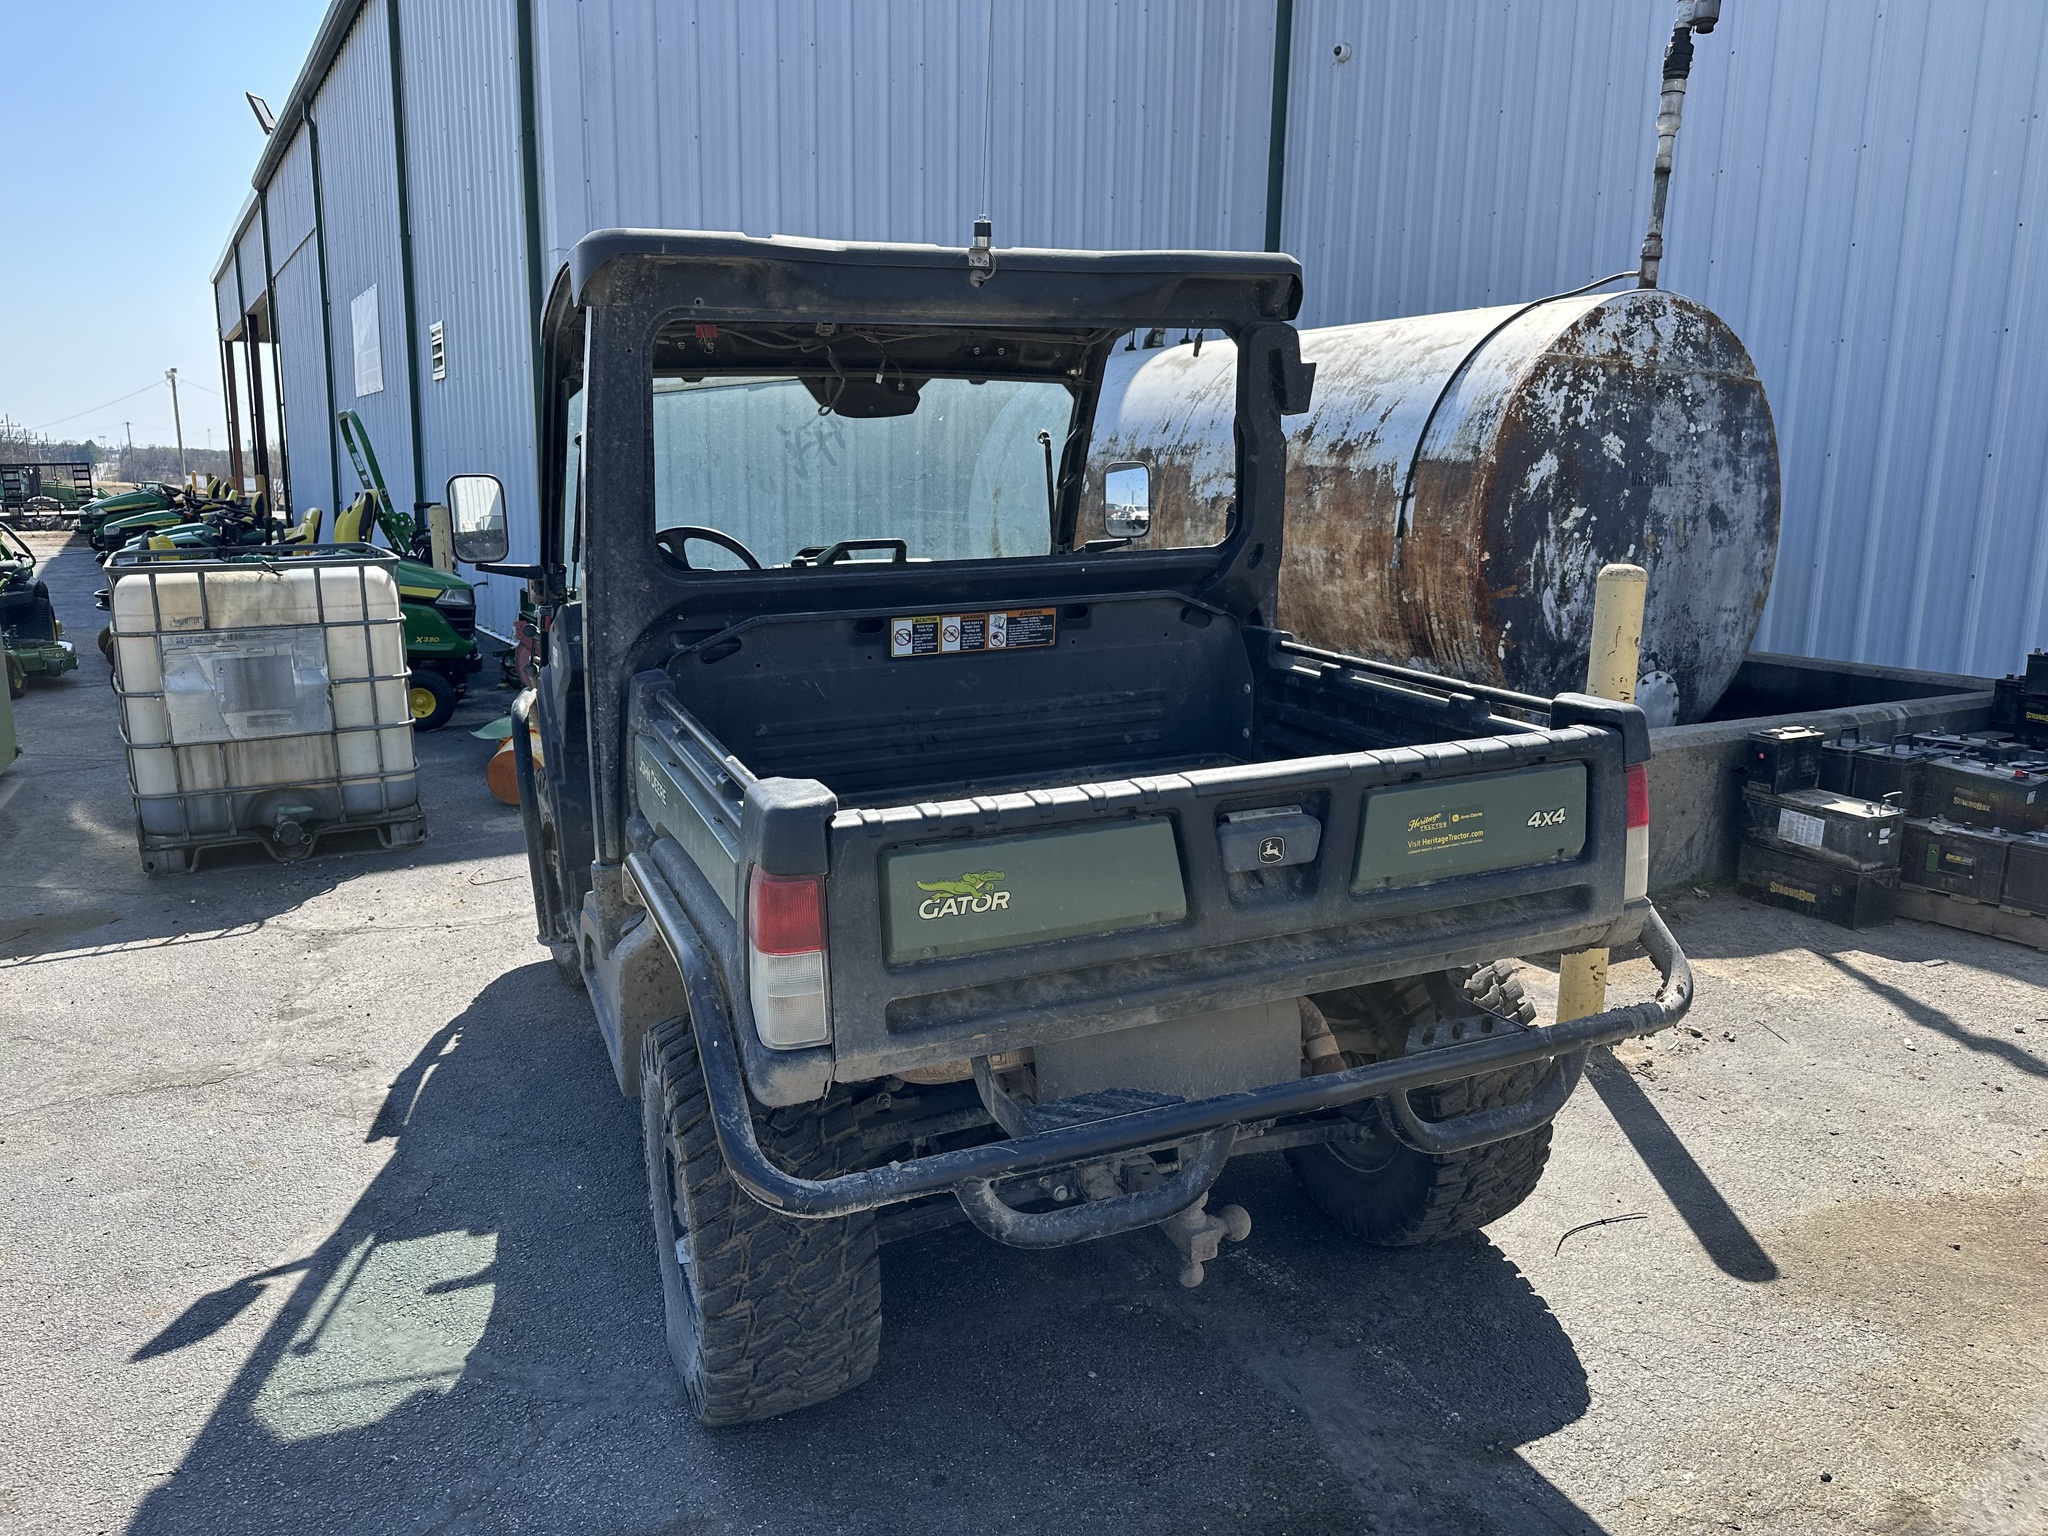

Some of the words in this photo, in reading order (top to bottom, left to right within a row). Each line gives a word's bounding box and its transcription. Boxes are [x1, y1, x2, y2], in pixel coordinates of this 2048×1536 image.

[650, 768, 667, 806] DEERE
[1407, 812, 1442, 832] Heritage
[1420, 821, 1447, 832] TRACTOR
[1407, 840, 1421, 848] Visit
[1422, 830, 1484, 846] HeritageTractor.com
[918, 891, 1011, 920] GATOR
